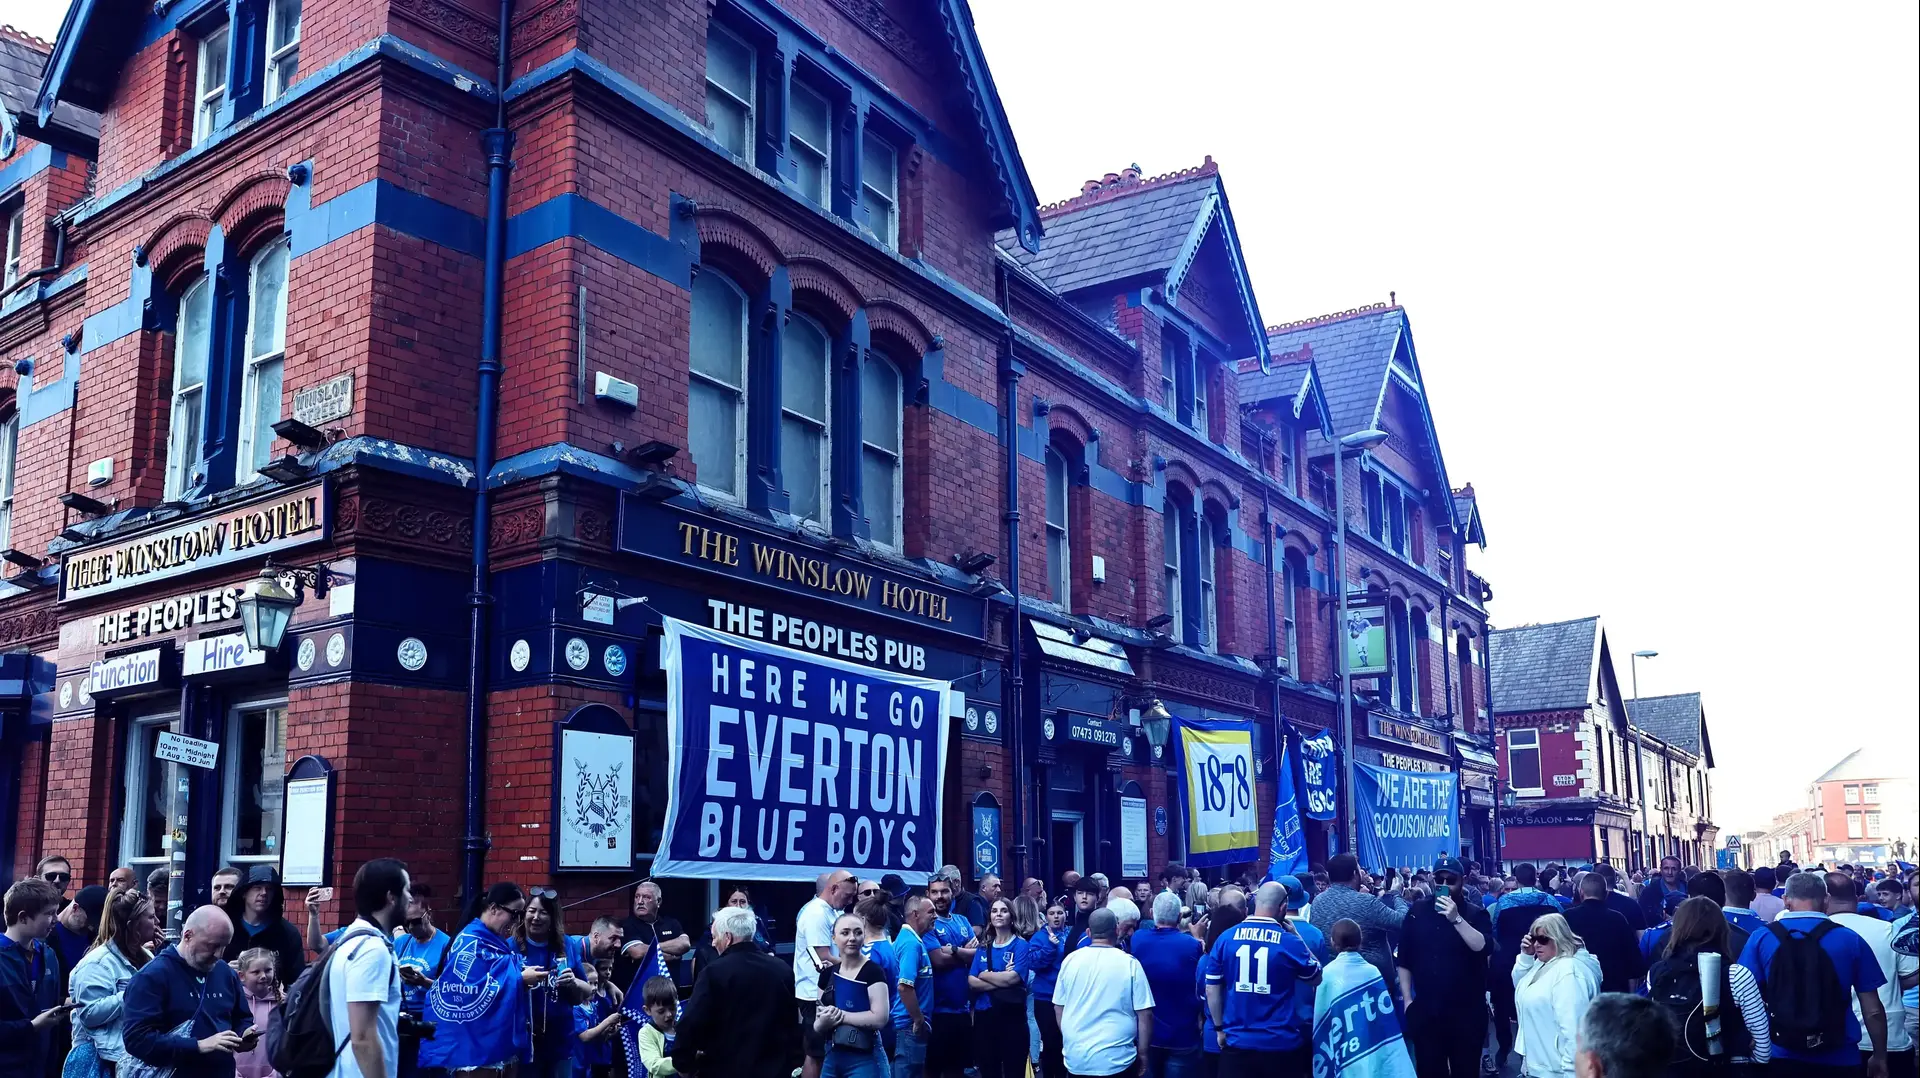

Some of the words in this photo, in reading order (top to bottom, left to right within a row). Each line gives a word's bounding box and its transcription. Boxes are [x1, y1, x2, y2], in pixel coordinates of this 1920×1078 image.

[65, 553, 113, 590] THE
[117, 522, 228, 579] WINSLOW
[229, 496, 318, 551] HOTEL
[678, 520, 740, 567] THE
[751, 541, 874, 601] WINSLOW
[881, 578, 953, 624] HOTEL
[92, 611, 131, 646] THE
[136, 587, 237, 637] PEOPLES
[707, 598, 764, 639] THE
[771, 612, 878, 663] PEOPLES
[884, 638, 926, 672] PUB
[202, 637, 245, 672] Hire
[90, 656, 156, 692] Function
[711, 652, 807, 709] HERE
[830, 677, 869, 721] WE
[889, 691, 924, 730] GO
[170, 734, 181, 744] No
[182, 737, 208, 750] loading
[1071, 725, 1092, 740] 07473
[1093, 729, 1117, 744] 091278
[1380, 720, 1393, 736] THE
[159, 742, 179, 752] 10am
[185, 747, 215, 760] Midnight
[166, 752, 181, 762] Aug
[187, 755, 197, 763] 30
[198, 758, 211, 767] Jun
[705, 704, 922, 817] EVERTON
[1382, 752, 1396, 768] THE
[1396, 755, 1421, 773] PEOPLES
[1197, 754, 1250, 817] 1878
[1376, 772, 1399, 808] WE
[1401, 775, 1428, 809] ARE
[1429, 779, 1450, 810] THE
[698, 801, 807, 862] BLUE
[826, 812, 917, 868] BOYS
[1374, 812, 1427, 839] GOODISON
[1427, 814, 1450, 838] GANG
[1526, 816, 1562, 824] SALON
[1233, 927, 1282, 945] AMOKACHI
[1235, 944, 1271, 995] 11
[441, 981, 479, 995] Everton
